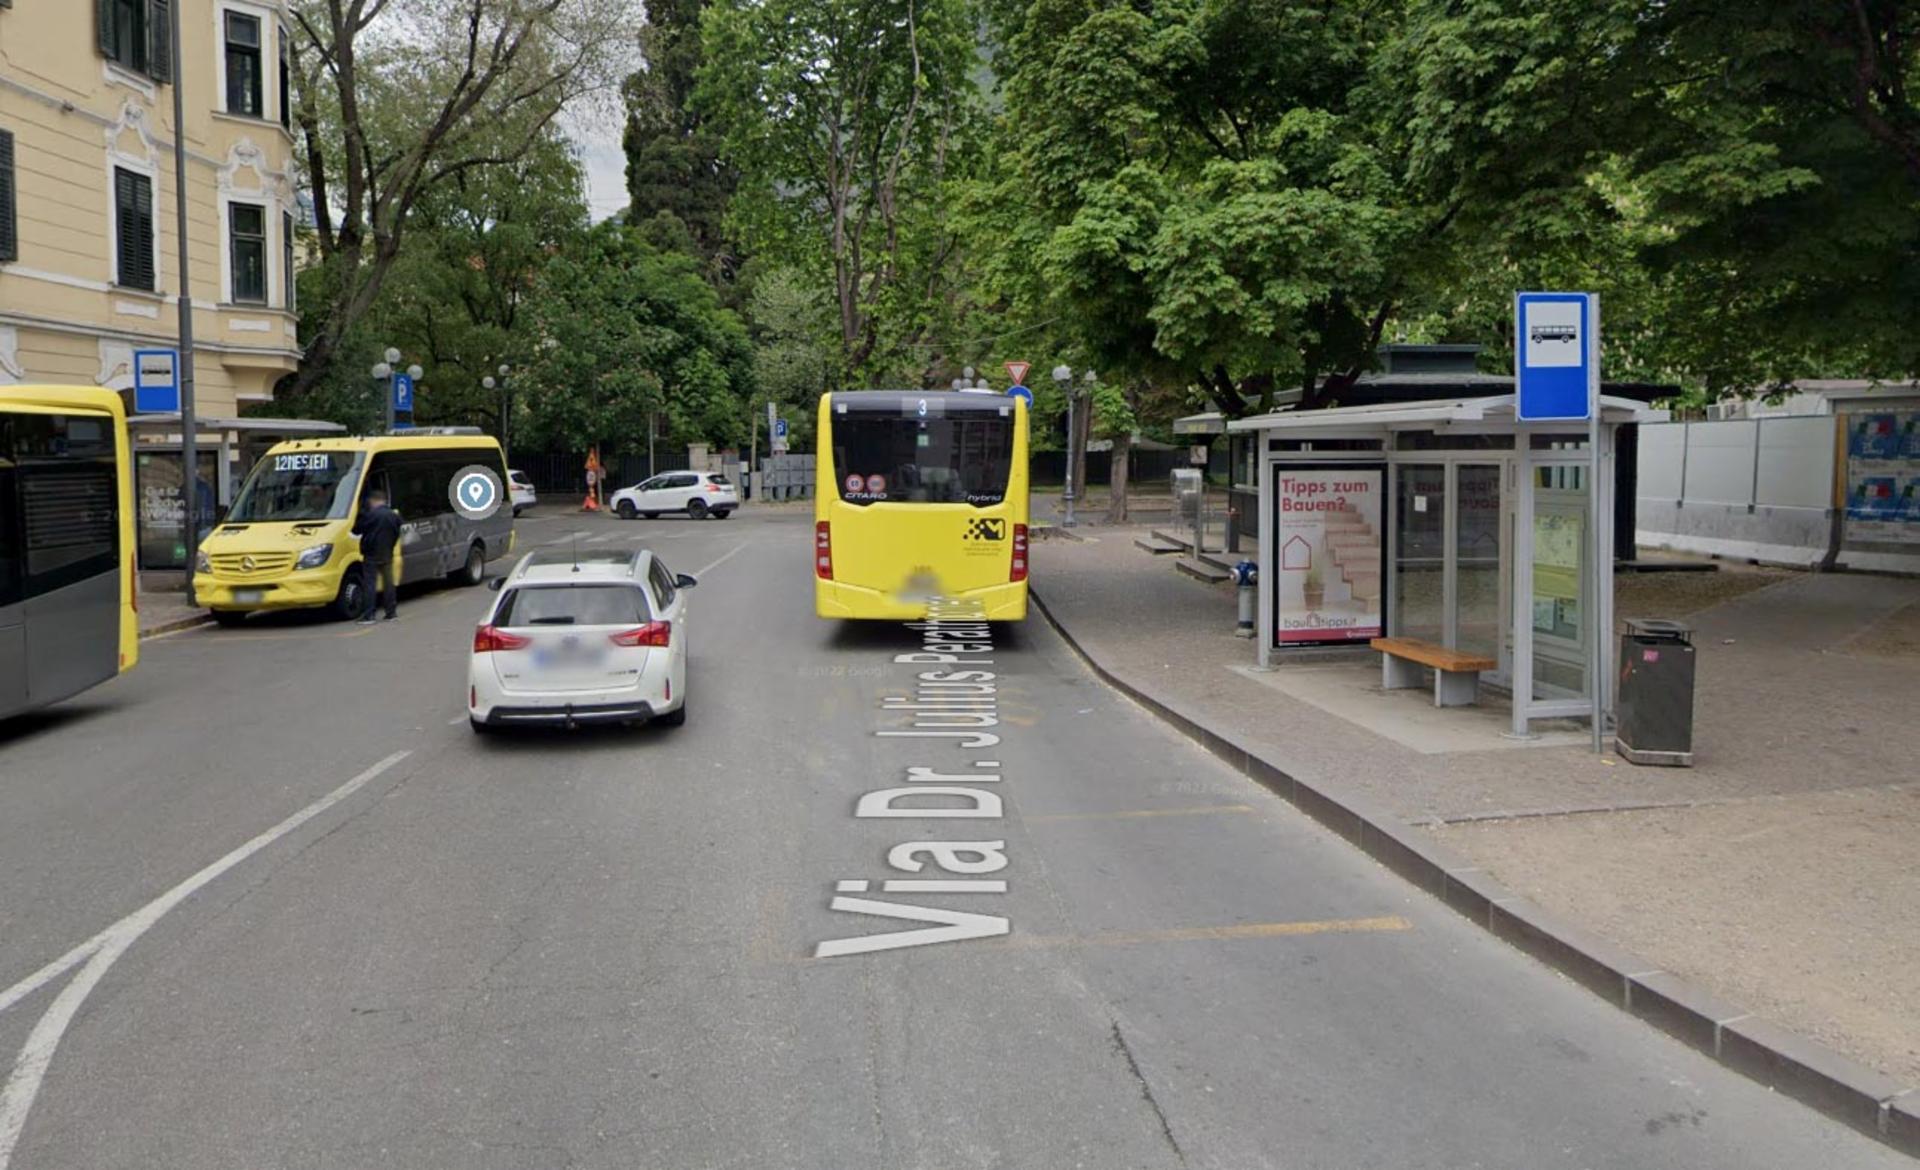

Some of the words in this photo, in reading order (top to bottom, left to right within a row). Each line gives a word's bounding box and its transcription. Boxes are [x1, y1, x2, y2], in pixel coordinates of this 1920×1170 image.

[918, 398, 928, 416] 3
[1281, 477, 1327, 497] Tipps
[1332, 481, 1369, 493] zum
[845, 491, 888, 500] CITARO
[967, 493, 1002, 503] hybrid
[1281, 496, 1346, 512] Bauen?
